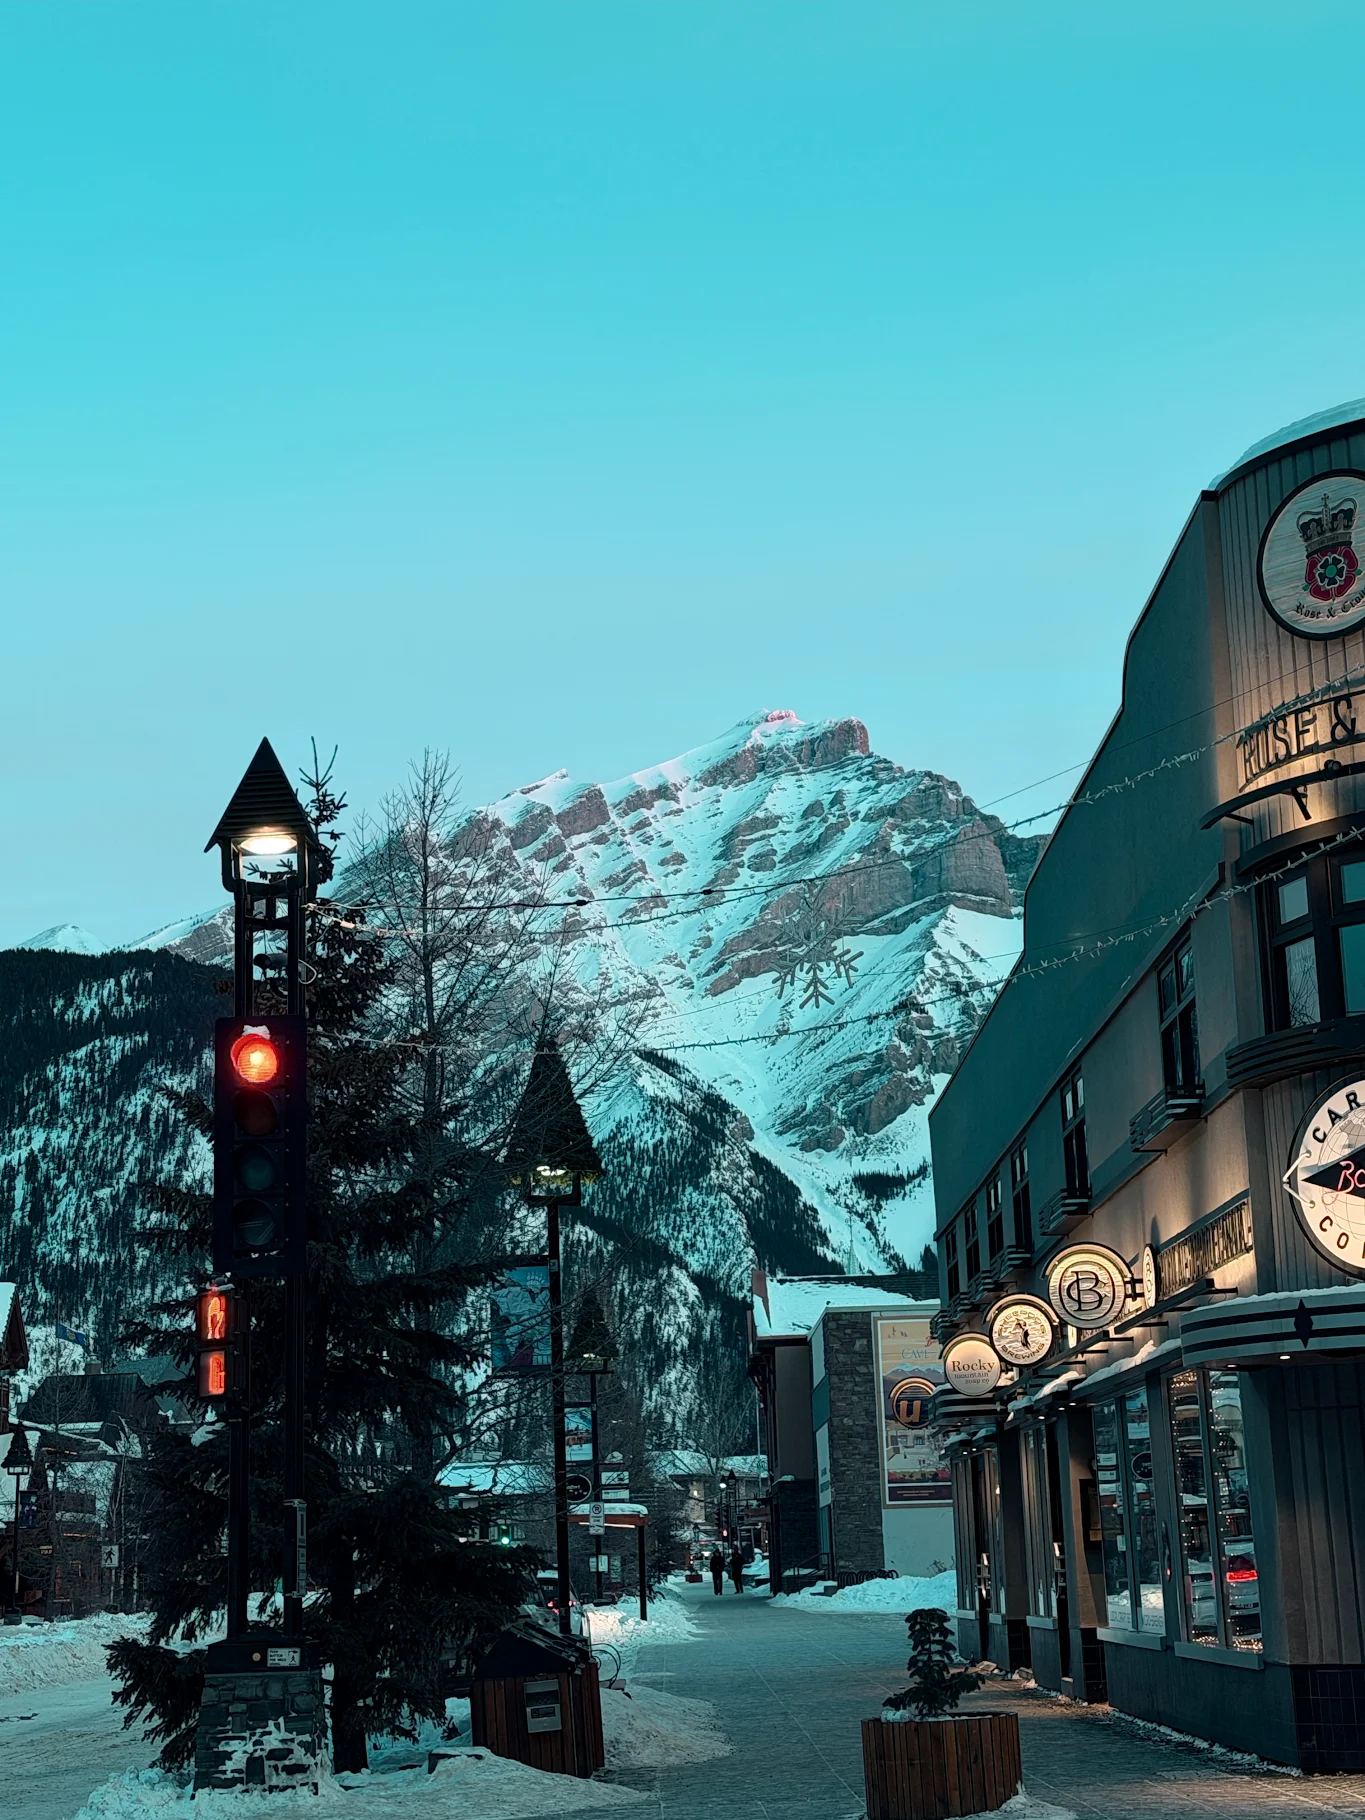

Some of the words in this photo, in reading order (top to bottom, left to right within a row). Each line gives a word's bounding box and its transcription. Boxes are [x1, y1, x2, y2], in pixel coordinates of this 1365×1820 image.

[1296, 602, 1321, 619] Rose
[1327, 606, 1336, 618] &
[1242, 707, 1319, 783] ROSE
[1331, 698, 1357, 744] &
[1319, 1215, 1365, 1259] CO
[1001, 1342, 1045, 1360] BREWING
[951, 1359, 995, 1373] Rocky
[954, 1372, 989, 1380] mountain
